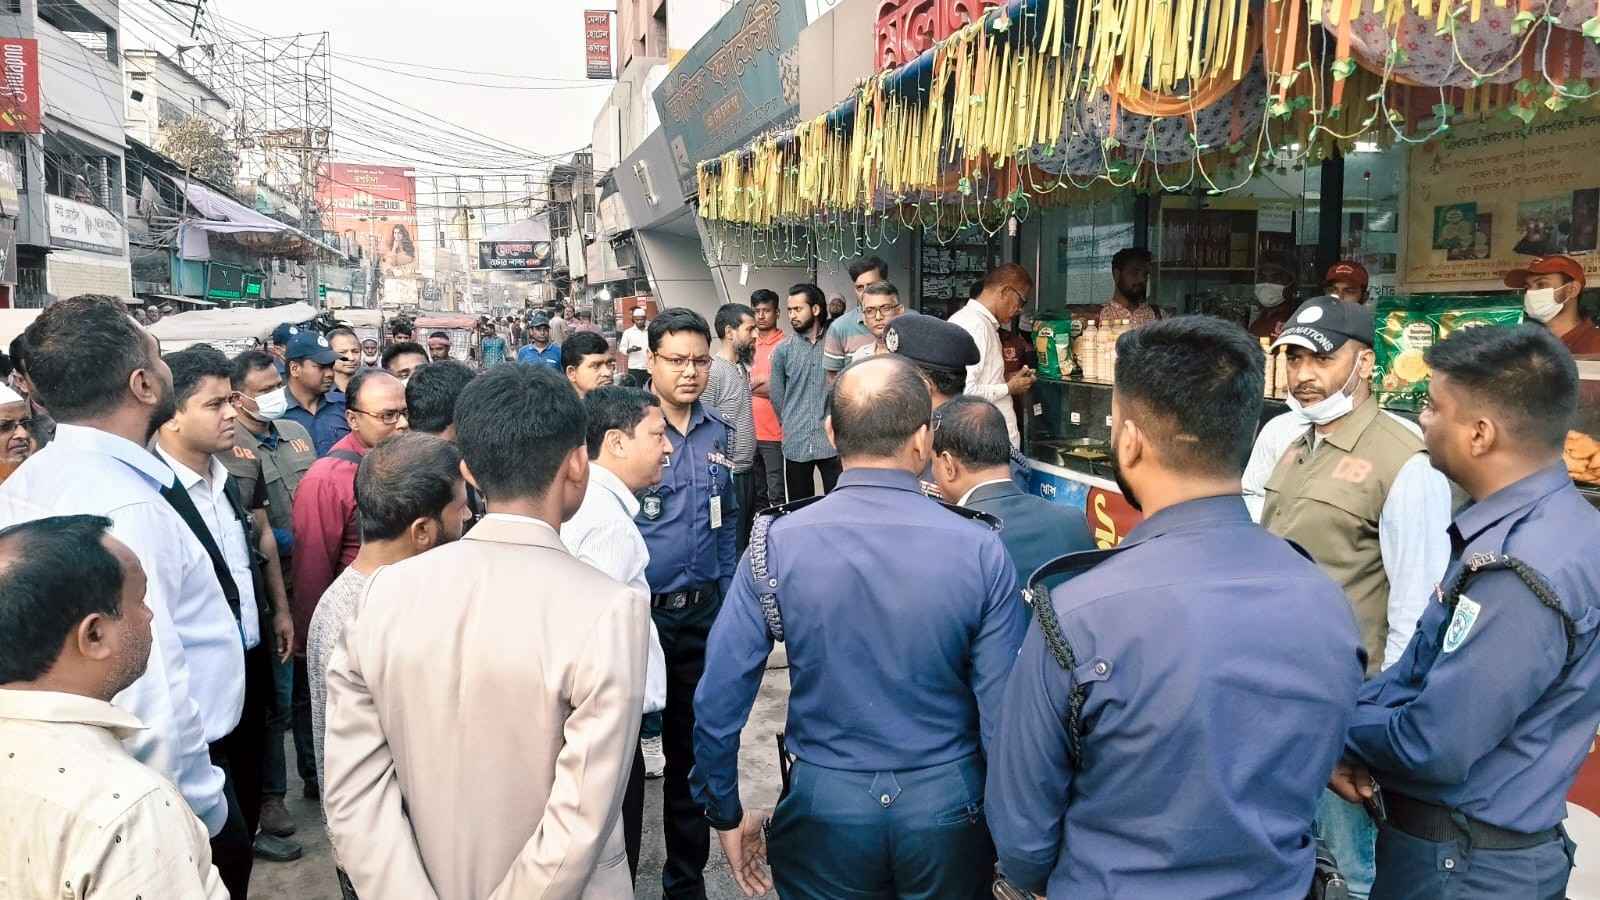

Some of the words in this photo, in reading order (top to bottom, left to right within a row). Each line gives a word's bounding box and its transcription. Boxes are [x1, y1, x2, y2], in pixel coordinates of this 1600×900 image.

[0, 43, 27, 103] Shwapno
[1295, 326, 1334, 352] NATIONS
[1332, 456, 1373, 483] DB
